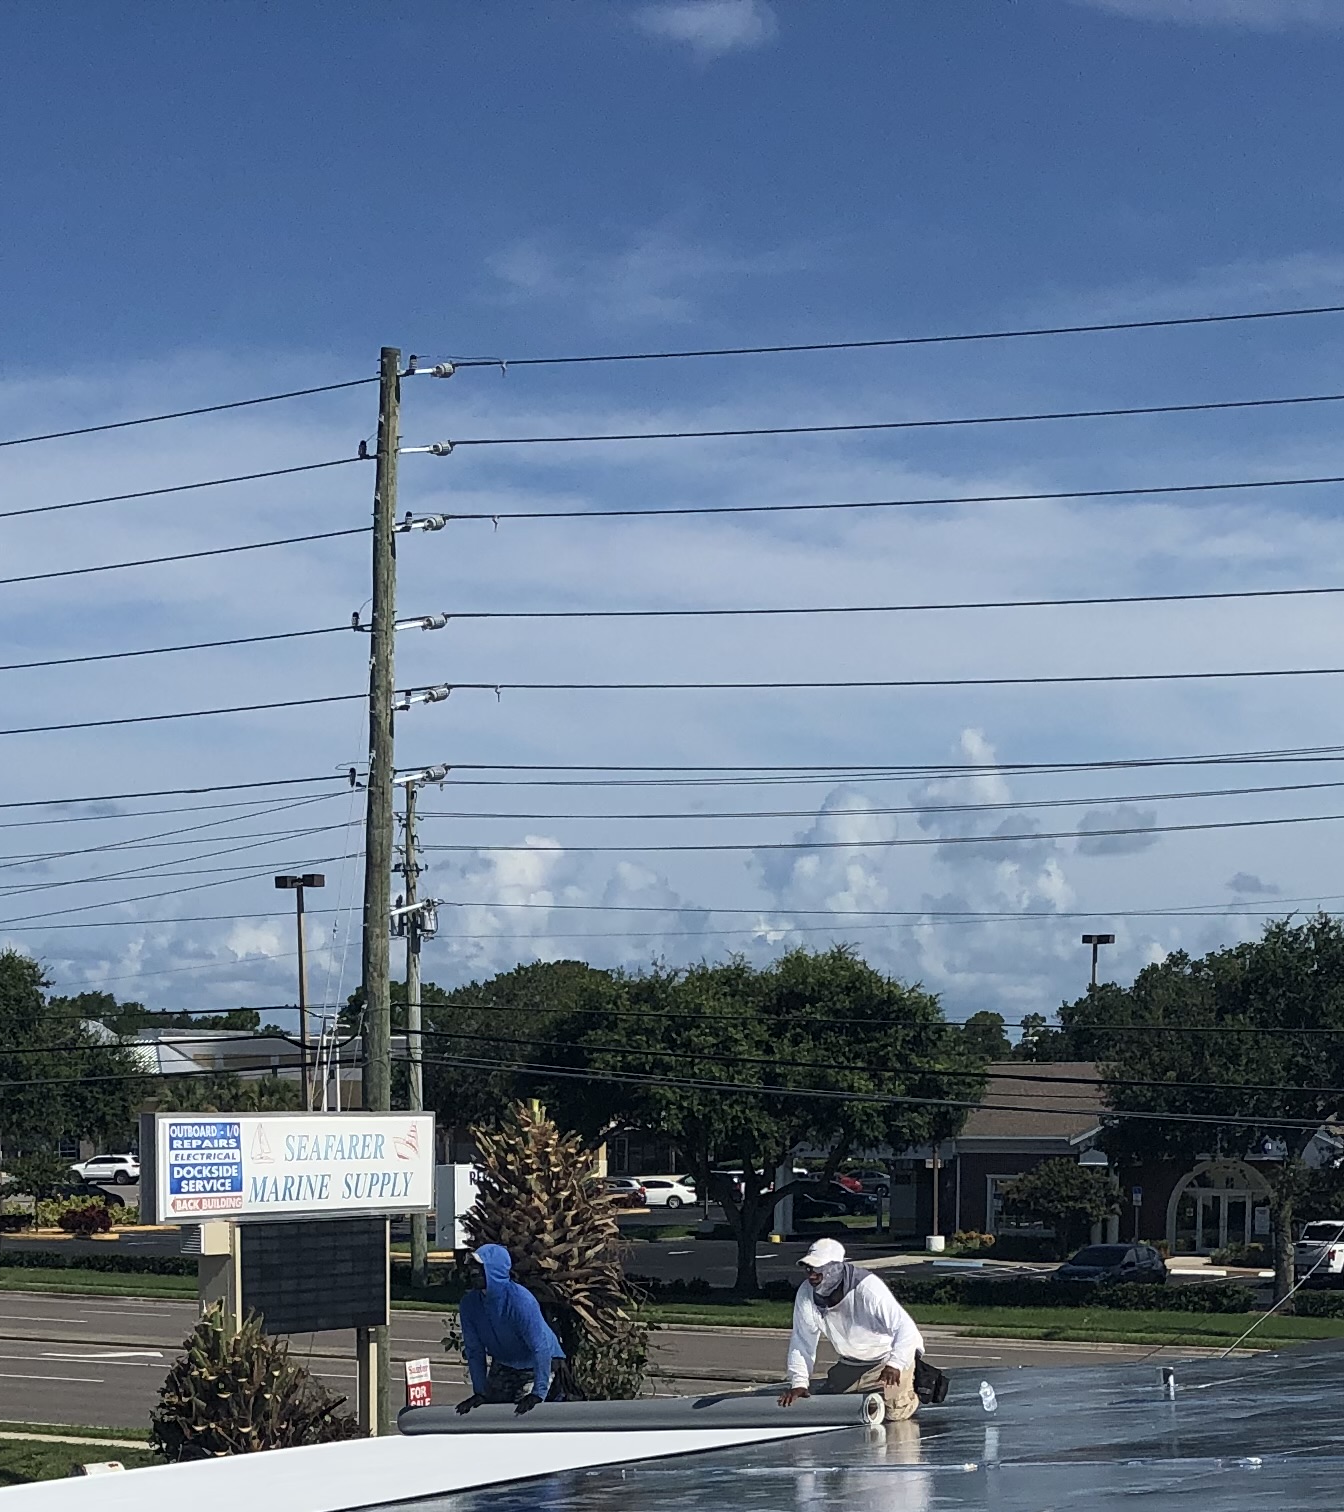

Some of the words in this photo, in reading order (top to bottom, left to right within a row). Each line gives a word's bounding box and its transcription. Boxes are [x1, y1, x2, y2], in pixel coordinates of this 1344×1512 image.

[170, 1125, 217, 1138] OUTBOARD
[227, 1125, 239, 1138] I/O
[173, 1139, 238, 1148] REPAIRS
[285, 1133, 385, 1161] SEAFARER
[174, 1152, 236, 1161] ELECTRICAL
[173, 1165, 238, 1178] DOCKSIDE
[181, 1179, 232, 1192] SERVICE
[248, 1174, 331, 1203] MARINE
[342, 1171, 413, 1200] SUPPLY
[176, 1199, 200, 1211] BACK
[202, 1197, 242, 1210] BUILDING
[410, 1386, 427, 1400] FOR
